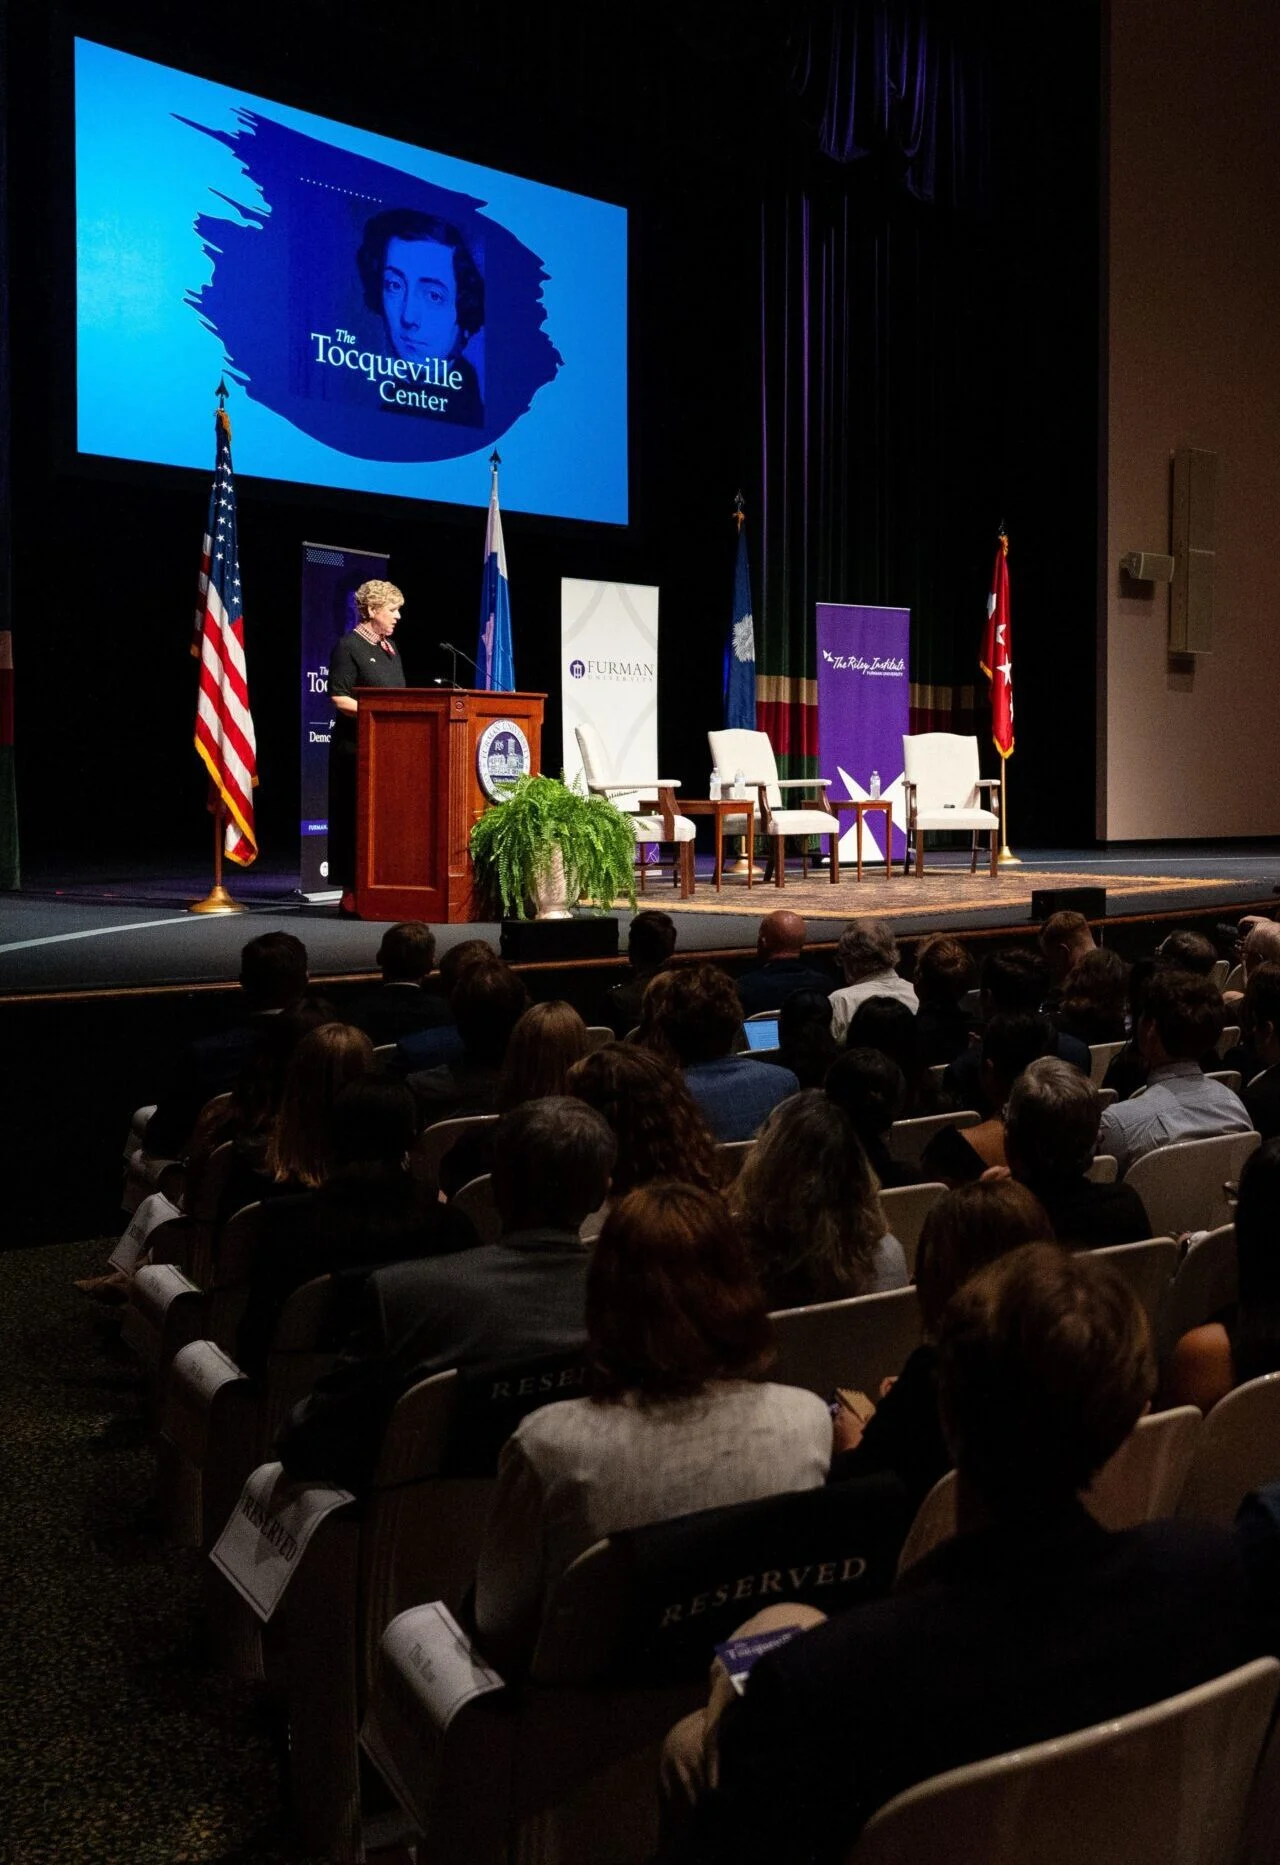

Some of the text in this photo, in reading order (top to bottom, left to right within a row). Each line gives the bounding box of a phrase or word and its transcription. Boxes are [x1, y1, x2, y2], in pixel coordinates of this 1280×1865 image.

[336, 328, 356, 344] The
[311, 332, 463, 390] Tocqueville
[379, 380, 448, 412] Center
[587, 660, 655, 676] FURMAN
[587, 674, 653, 682] UNIVERSITY
[833, 655, 904, 675] The Riley Institute
[241, 1497, 297, 1562] RESERVED
[659, 1556, 868, 1629] RESERVED
